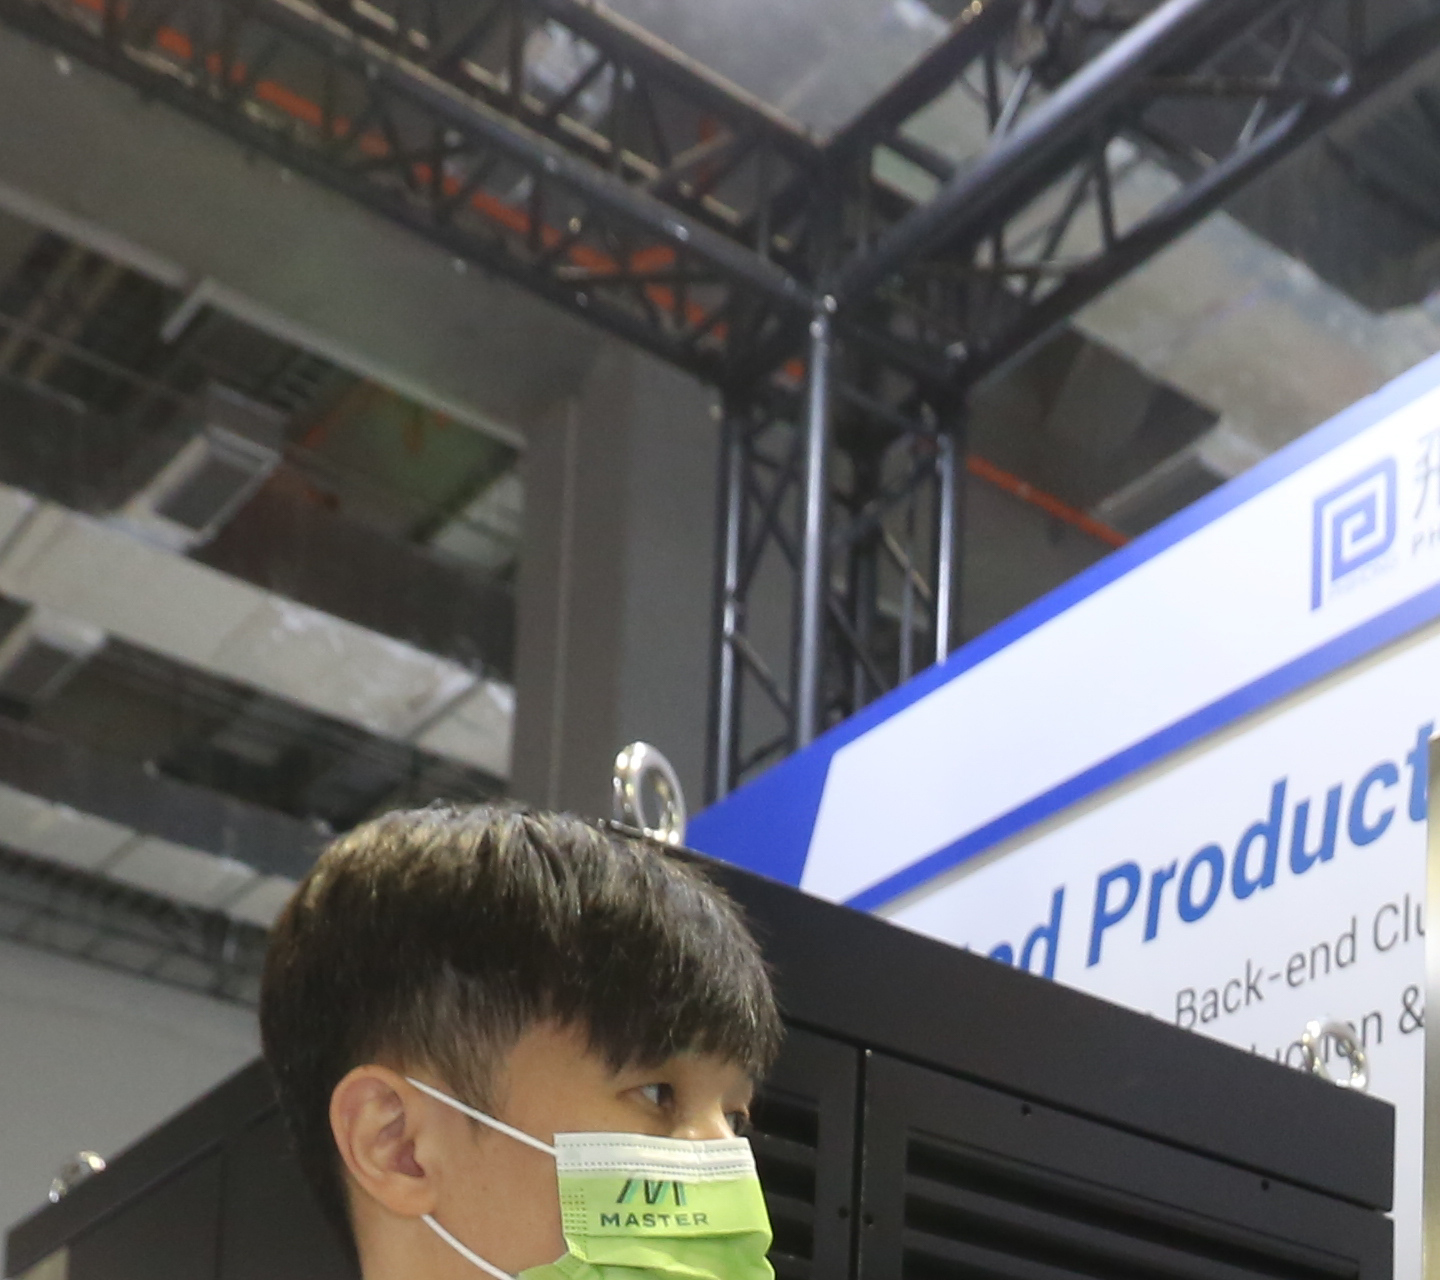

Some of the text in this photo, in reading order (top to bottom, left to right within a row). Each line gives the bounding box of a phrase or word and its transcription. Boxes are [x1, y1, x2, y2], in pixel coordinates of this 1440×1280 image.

[1085, 721, 1431, 969] Product
[1175, 915, 1357, 1031] Back-end
[599, 1211, 709, 1228] MASTER
